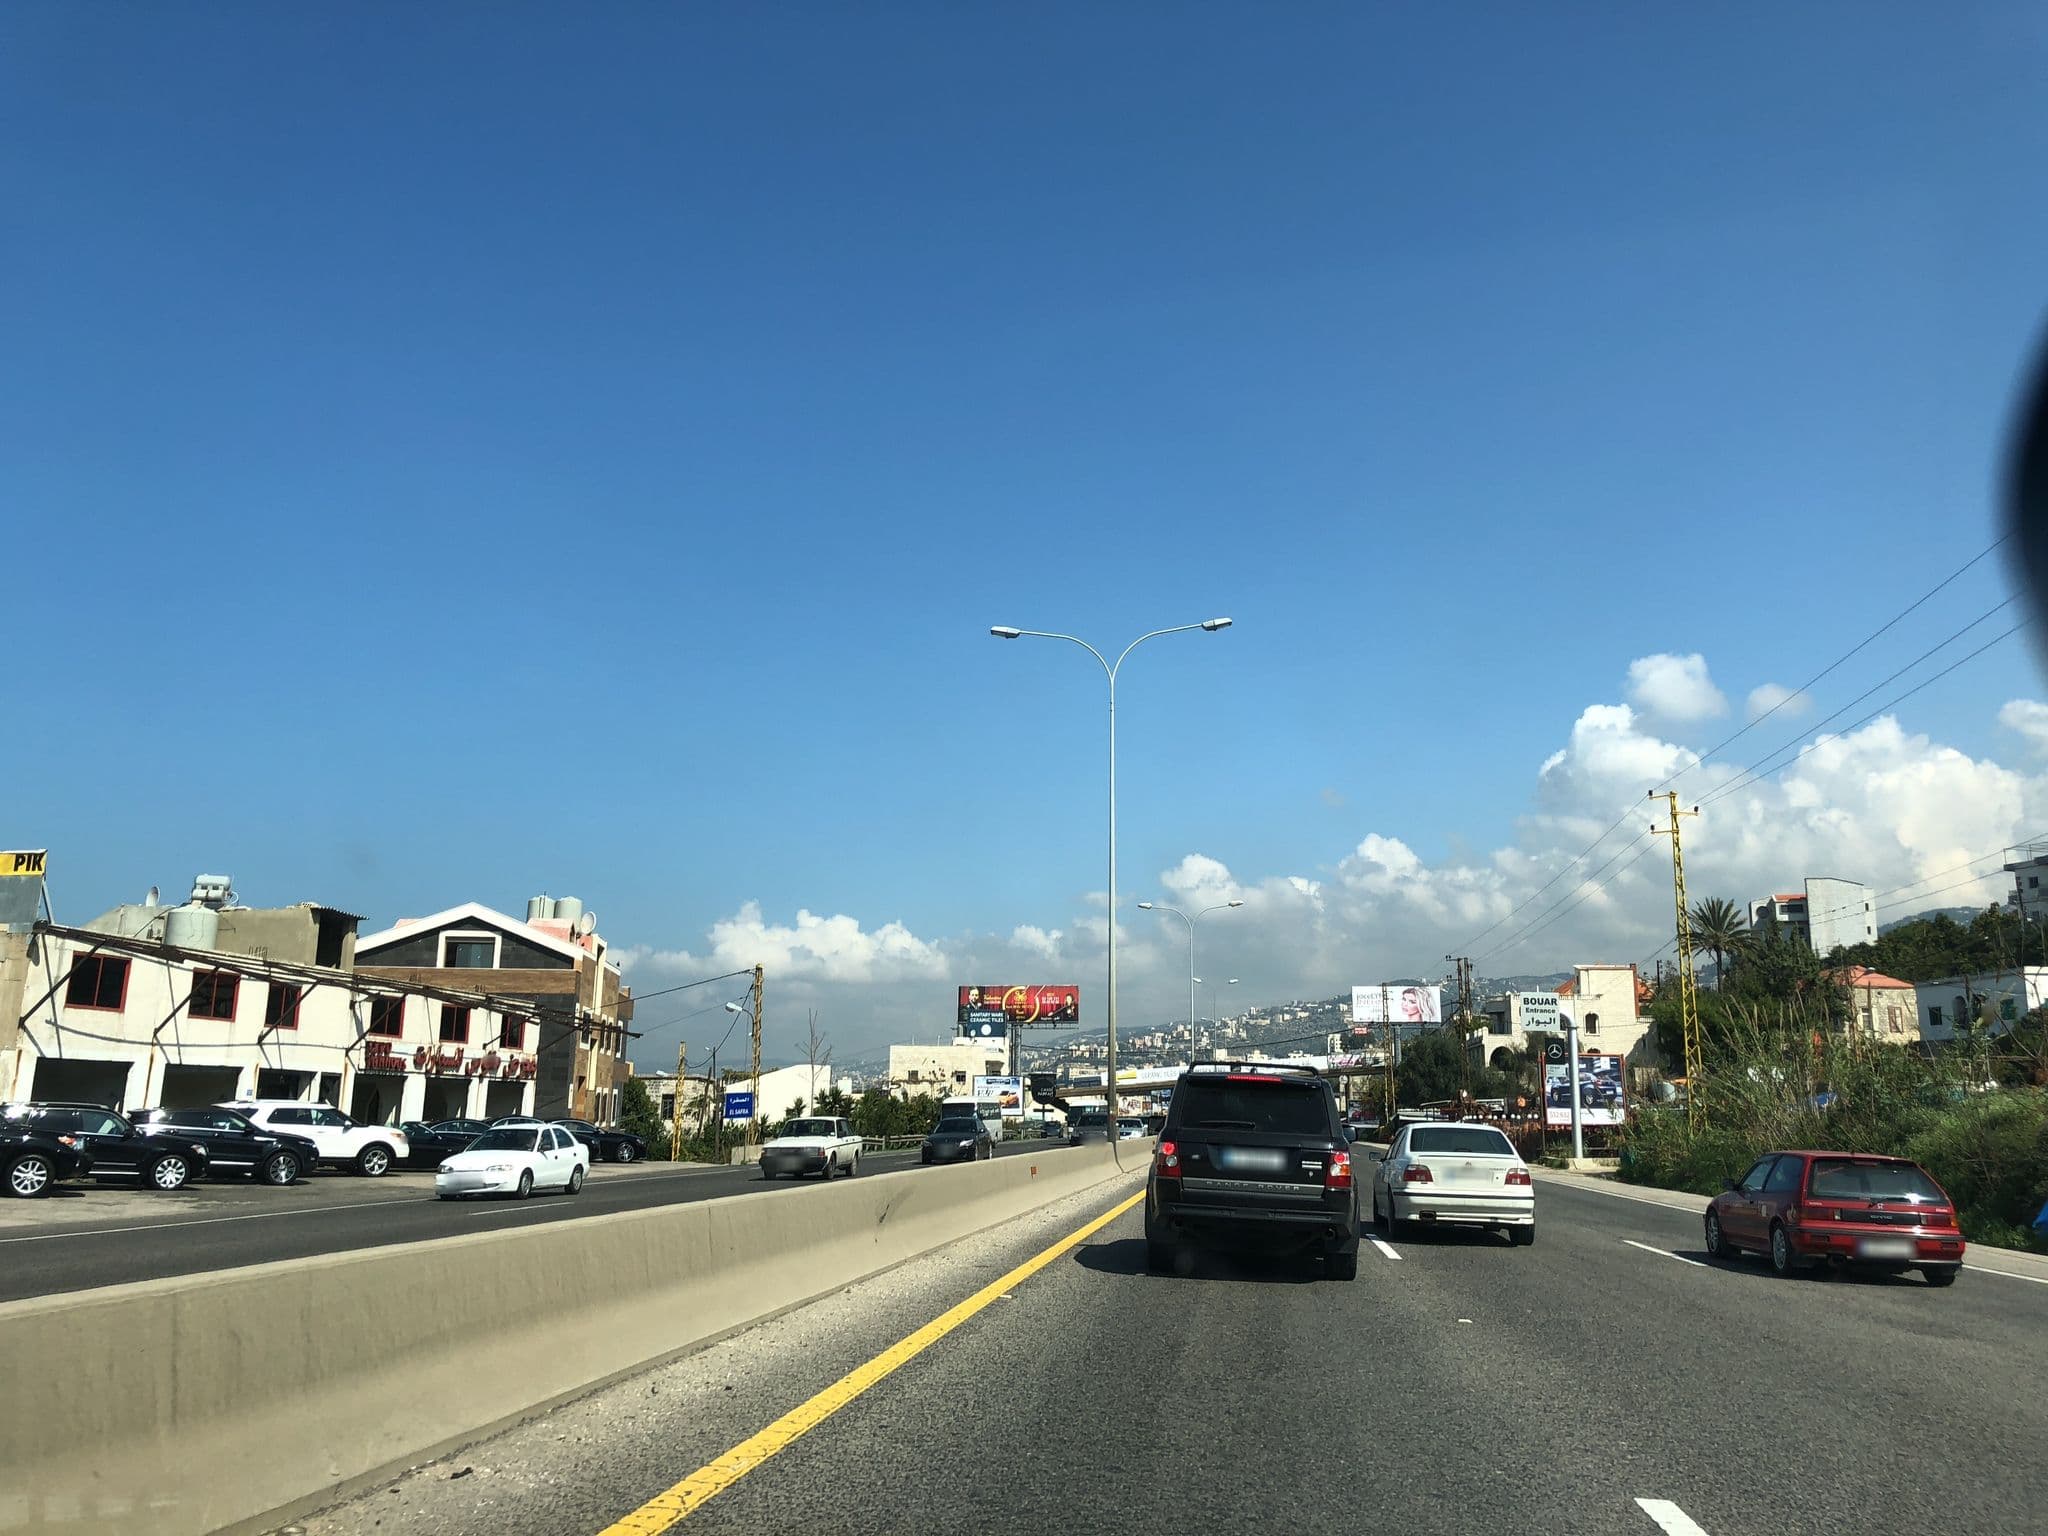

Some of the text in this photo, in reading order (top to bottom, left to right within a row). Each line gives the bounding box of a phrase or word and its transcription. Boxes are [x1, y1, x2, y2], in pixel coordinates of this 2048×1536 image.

[14, 852, 45, 872] PIK
[1523, 997, 1558, 1006] BOUAR
[1525, 1017, 1556, 1027] البوار
